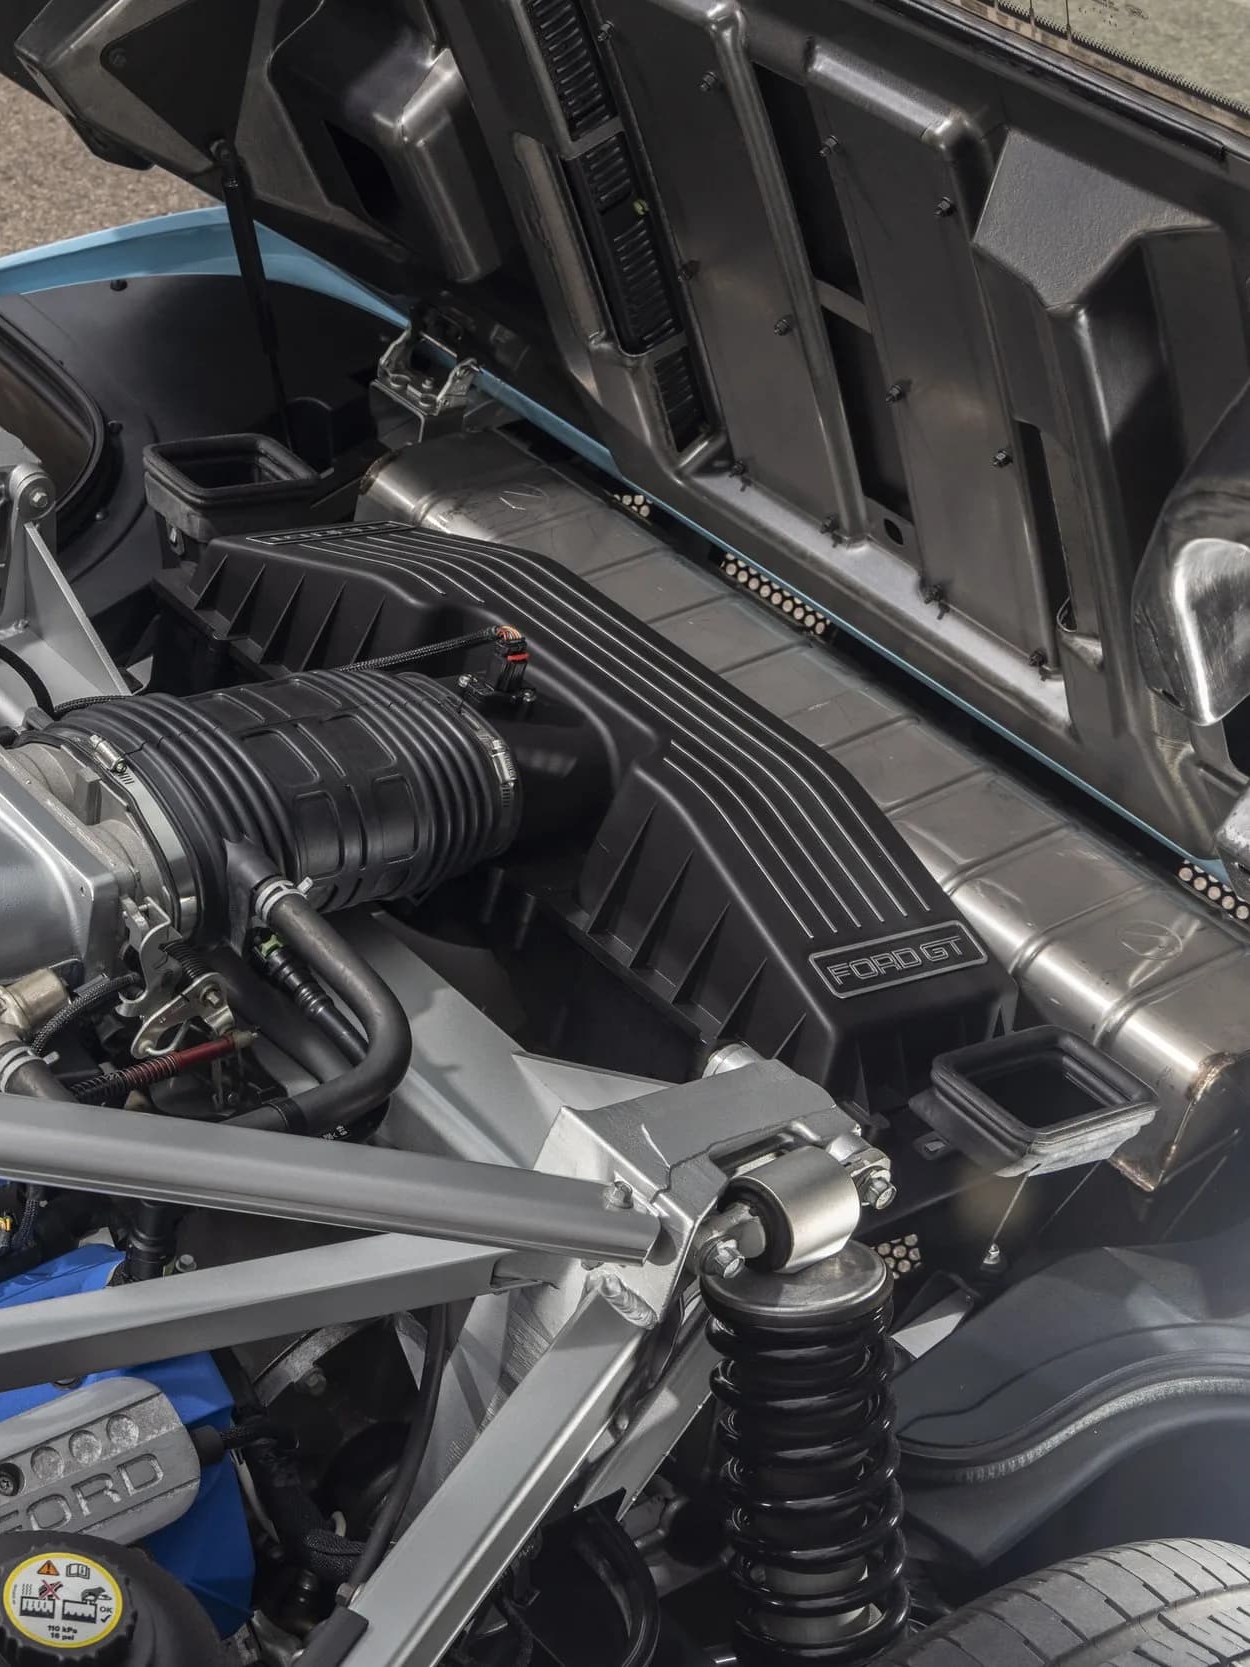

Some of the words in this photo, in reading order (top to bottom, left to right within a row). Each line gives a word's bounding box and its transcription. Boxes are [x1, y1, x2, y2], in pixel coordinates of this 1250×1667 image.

[827, 947, 923, 986] FORD
[919, 935, 963, 962] GT
[99, 1606, 113, 1614] OK
[62, 1625, 78, 1634] kPa
